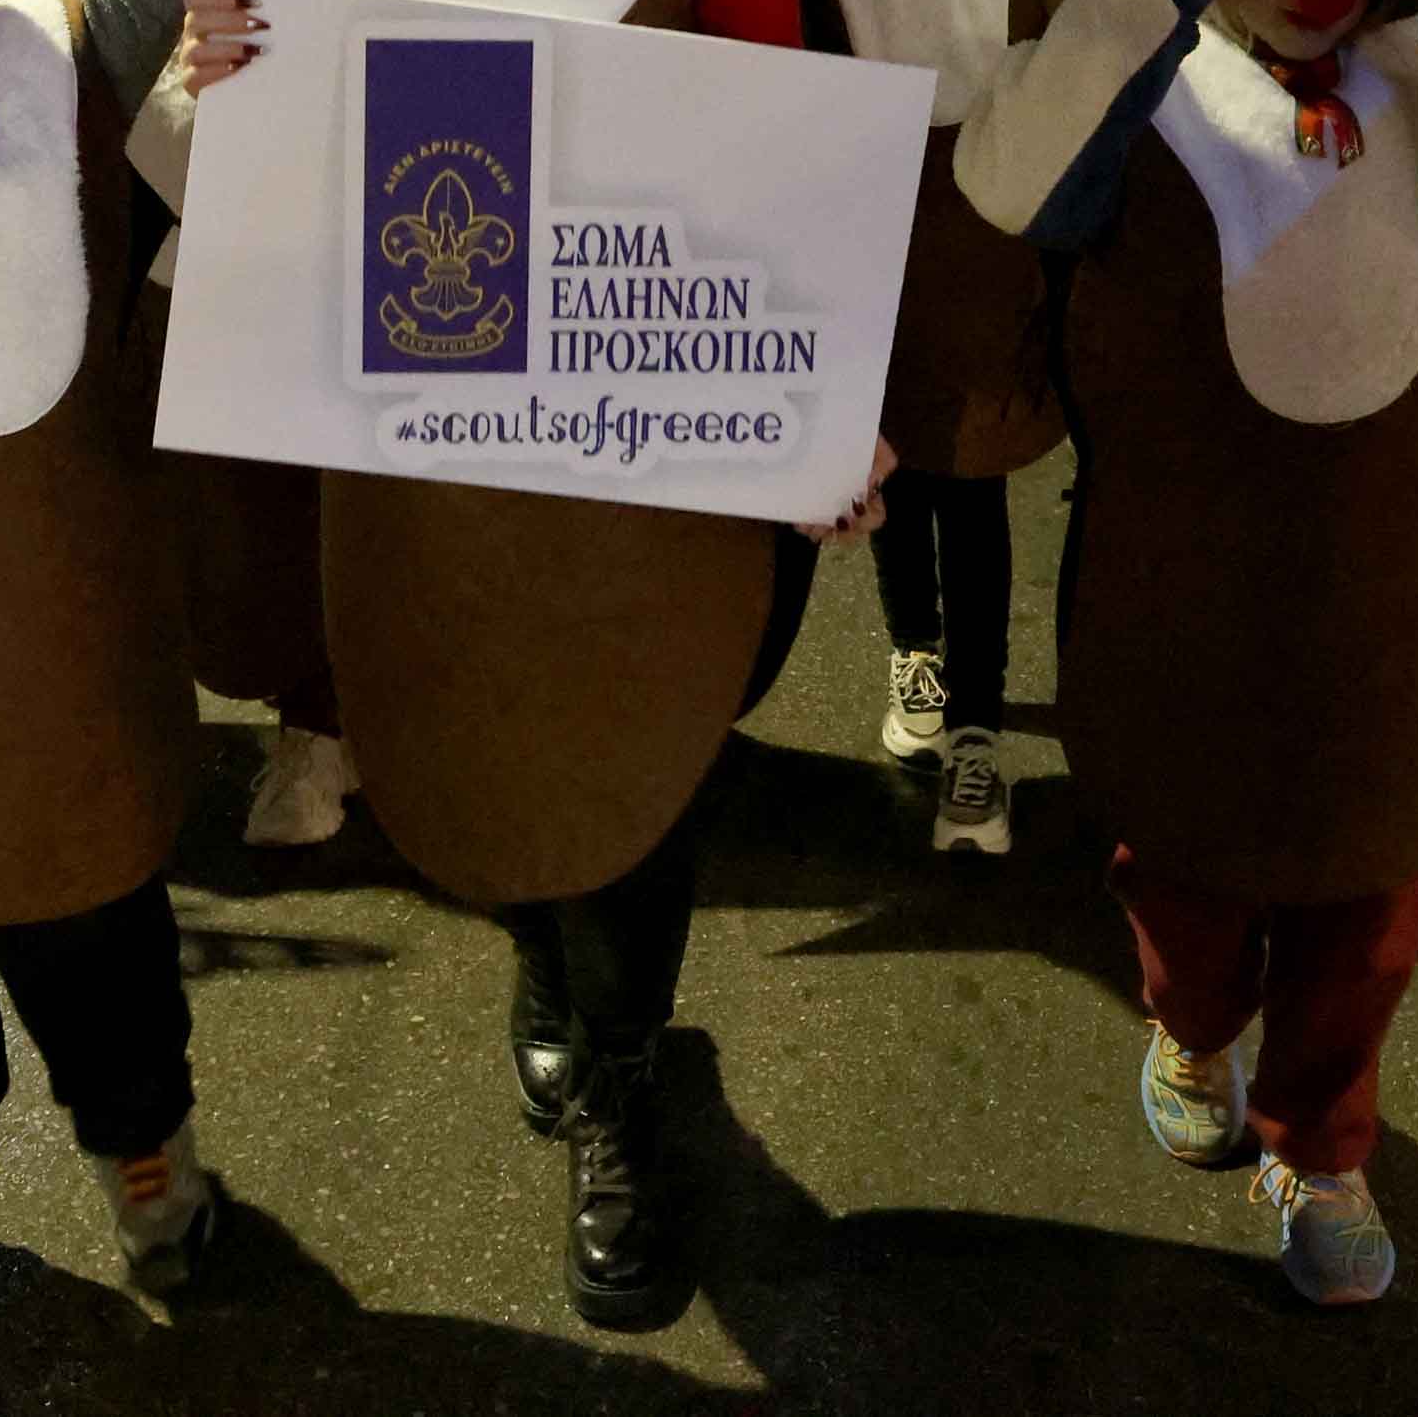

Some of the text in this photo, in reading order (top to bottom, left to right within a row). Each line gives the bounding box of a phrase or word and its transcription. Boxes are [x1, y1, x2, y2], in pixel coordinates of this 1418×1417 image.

[550, 223, 672, 268] ΣΩΜΑ
[550, 276, 750, 321] ΕΛΛΗΝΩΝ
[549, 329, 817, 374] ΠΡΟΣΚΟΠΩΝ
[395, 394, 783, 466] #scoutsofgreece
